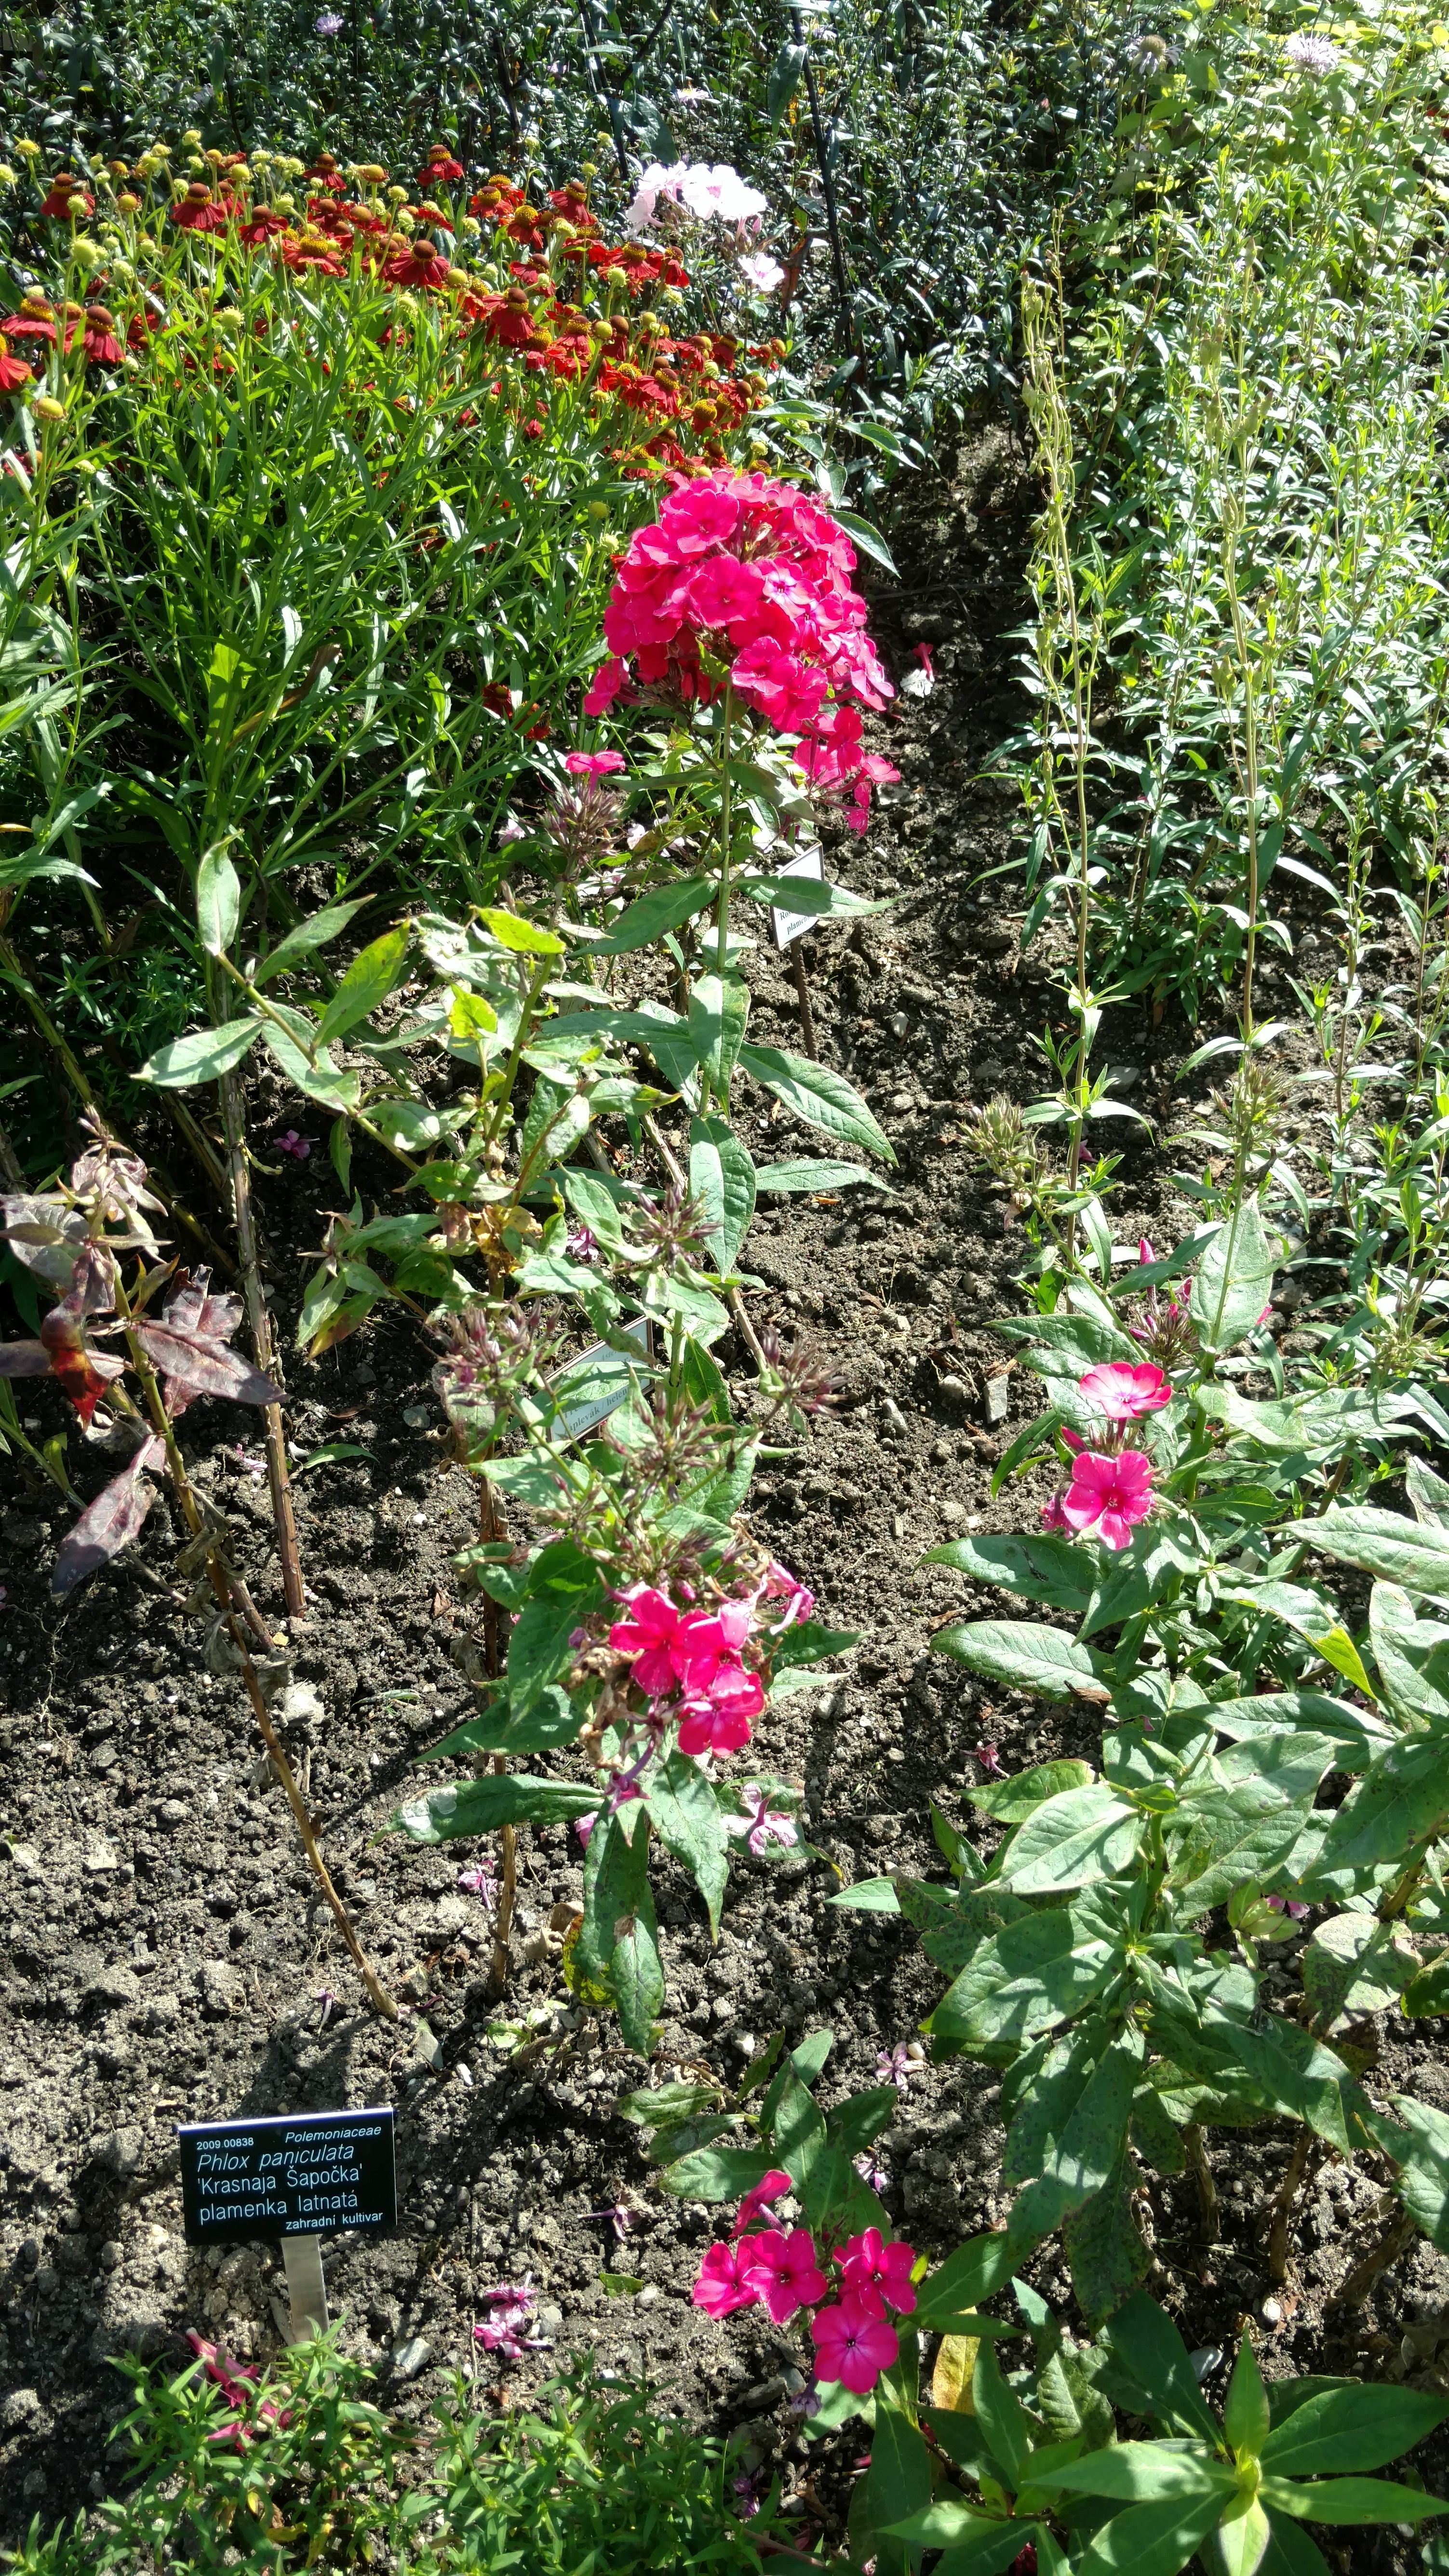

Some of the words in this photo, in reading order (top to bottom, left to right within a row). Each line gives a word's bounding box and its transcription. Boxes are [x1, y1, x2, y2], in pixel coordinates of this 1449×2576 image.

[606, 1388, 629, 1406] helen
[196, 2137, 254, 2150] 2009.00838
[285, 2126, 381, 2143] Polemoniaceae
[197, 2152, 250, 2172] Phlox
[259, 2144, 355, 2171] paniculata
[197, 2174, 276, 2195] 'Krasnaja
[287, 2163, 362, 2189] Šapočka'
[200, 2199, 287, 2226] plamenka
[297, 2189, 358, 2212] latnatá
[286, 2216, 336, 2230] zahradní
[342, 2211, 383, 2225] kultivar
